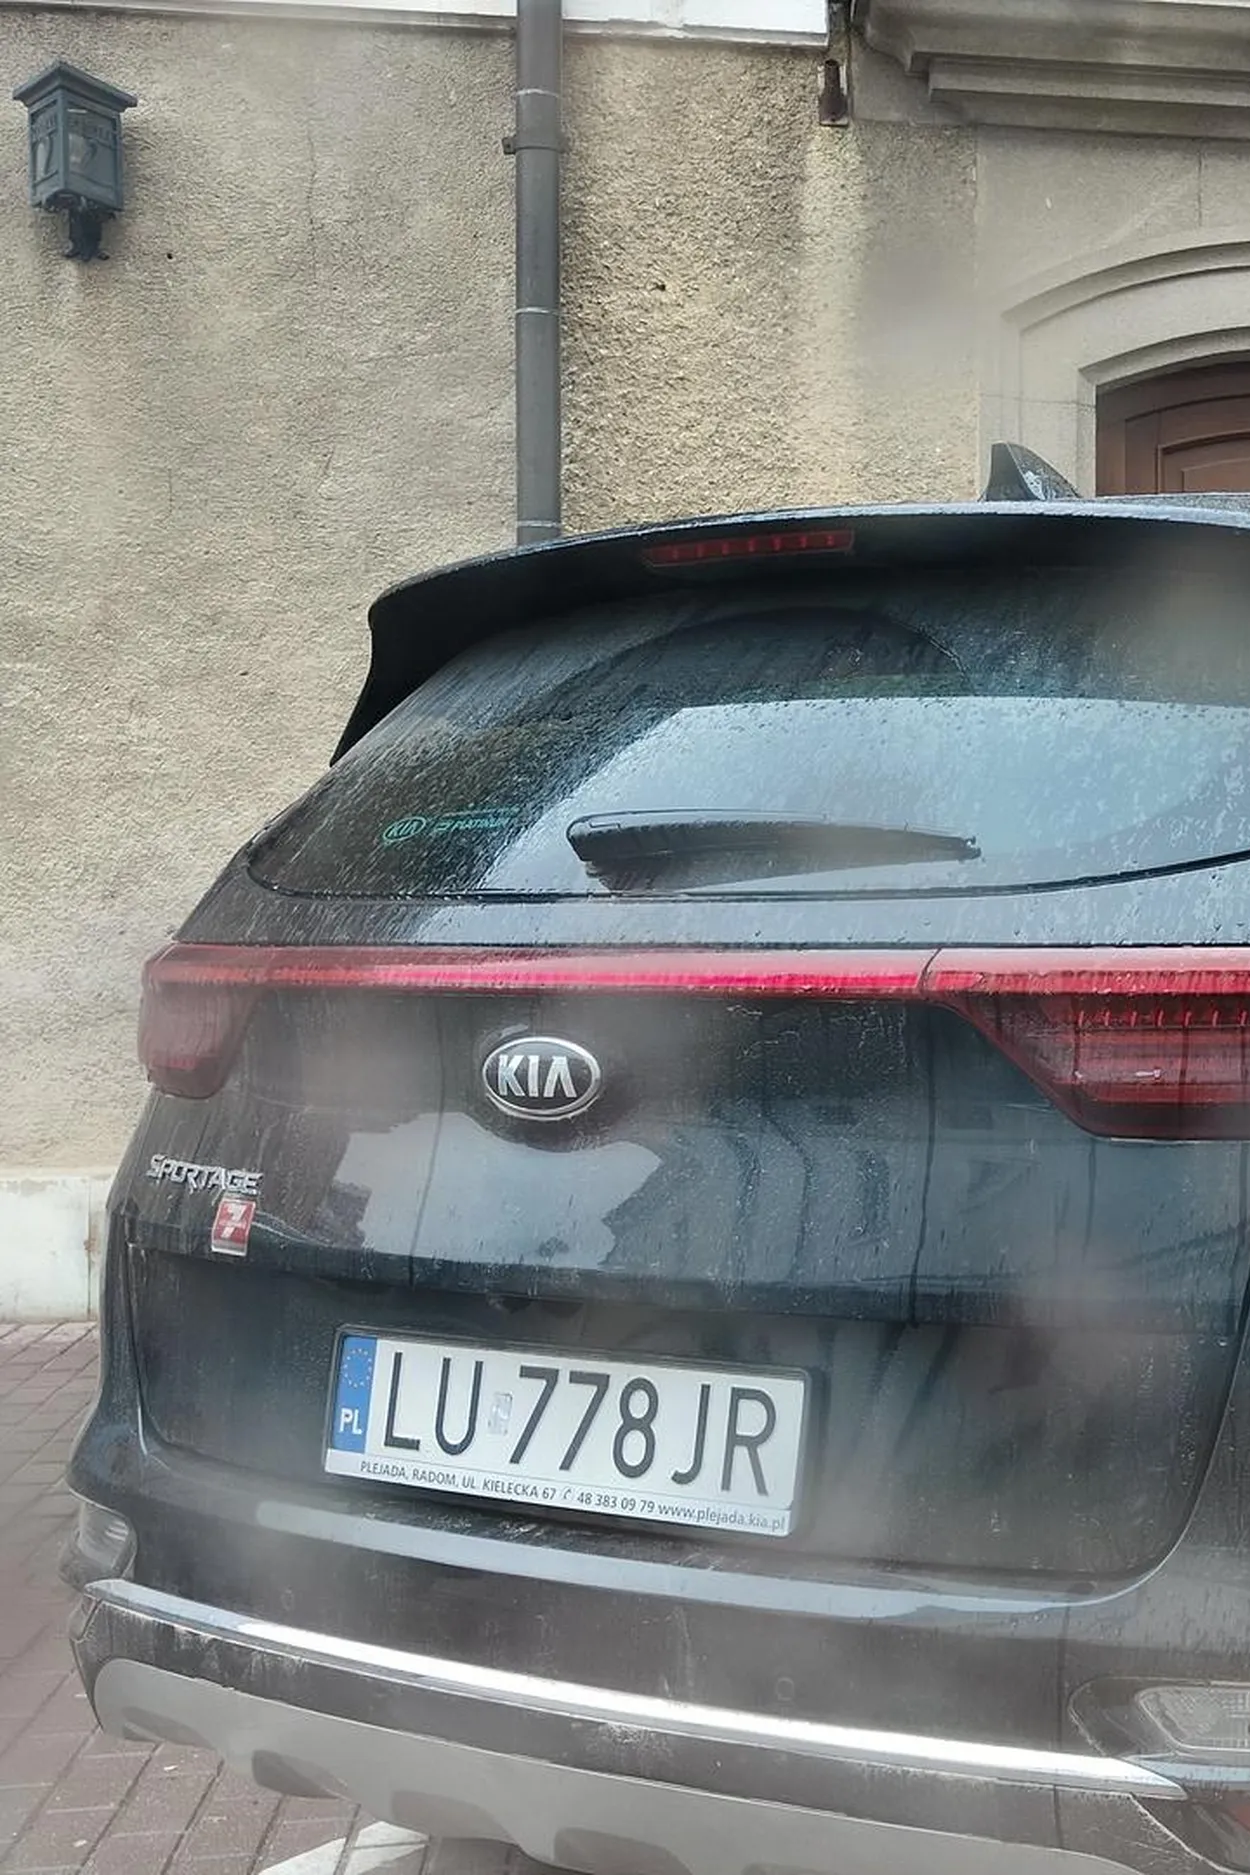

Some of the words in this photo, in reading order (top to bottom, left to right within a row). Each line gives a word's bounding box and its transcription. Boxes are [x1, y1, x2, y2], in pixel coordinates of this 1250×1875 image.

[498, 1054, 577, 1098] KIA
[146, 1154, 264, 1195] SPORTAGE
[339, 1407, 362, 1435] PL
[384, 1351, 483, 1456] LU
[360, 1460, 408, 1481] PLEJADA,
[411, 1468, 459, 1489] RADOM,
[482, 1477, 538, 1498] KIELECKA
[542, 1487, 556, 1500] 67
[577, 1492, 593, 1505] 48
[595, 1495, 617, 1508] 383
[620, 1498, 636, 1512] 09
[639, 1501, 655, 1513] 79
[658, 1504, 785, 1530] www.plejada.kia.pl
